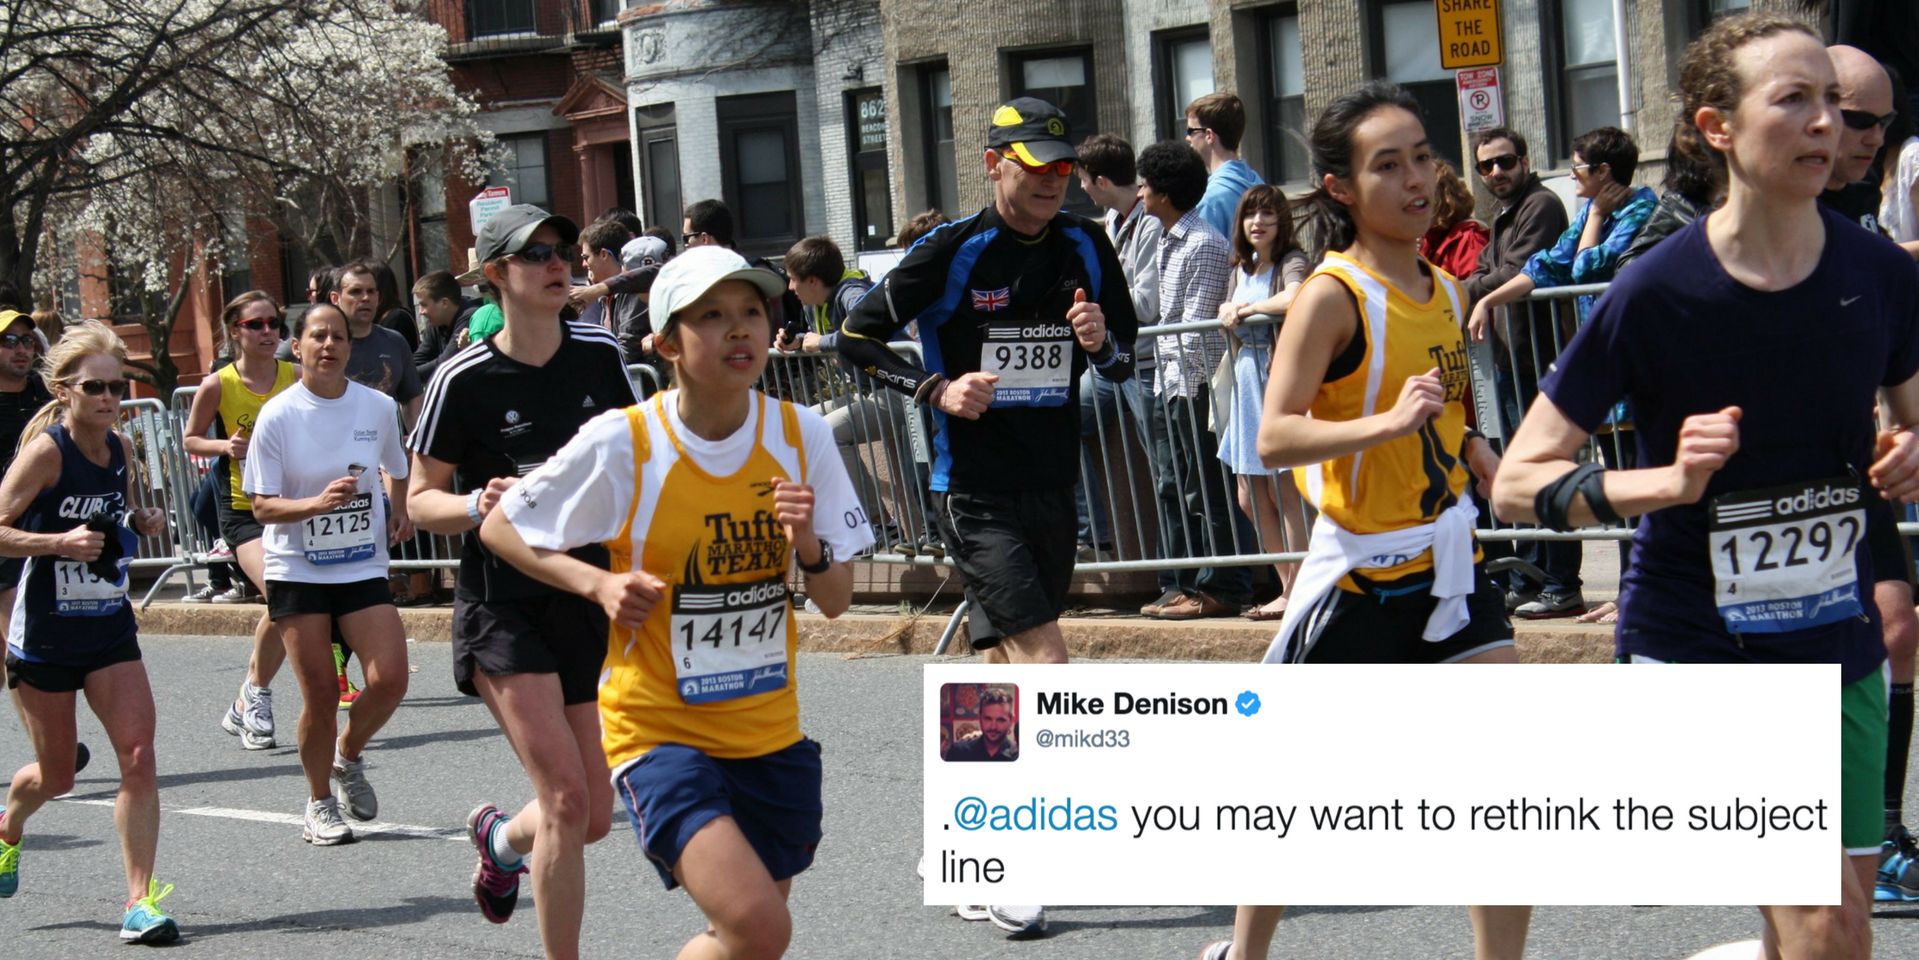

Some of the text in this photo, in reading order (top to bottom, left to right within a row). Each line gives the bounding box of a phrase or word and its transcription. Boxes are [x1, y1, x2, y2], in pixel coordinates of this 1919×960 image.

[1443, 0, 1491, 12] SHARE
[1454, 19, 1483, 37] THE
[1450, 40, 1490, 58] ROAD
[1459, 69, 1496, 80] TOW ZONE
[861, 99, 885, 118] 862
[1470, 114, 1494, 122] SNOW
[863, 134, 886, 144] STREET
[1022, 323, 1072, 338] adidas
[995, 344, 1062, 370] 9388
[1776, 486, 1860, 515] adidas
[306, 512, 370, 537] 12125
[708, 552, 783, 576] TEAM
[62, 587, 68, 596] 3
[727, 582, 785, 606] adidas
[1727, 582, 1738, 595] 4
[1745, 602, 1802, 615] 2013 BOSTON
[681, 604, 785, 651] 14147
[683, 657, 691, 670] 6
[701, 674, 744, 686] 2013 BOSTON
[701, 680, 745, 694] MARATHON
